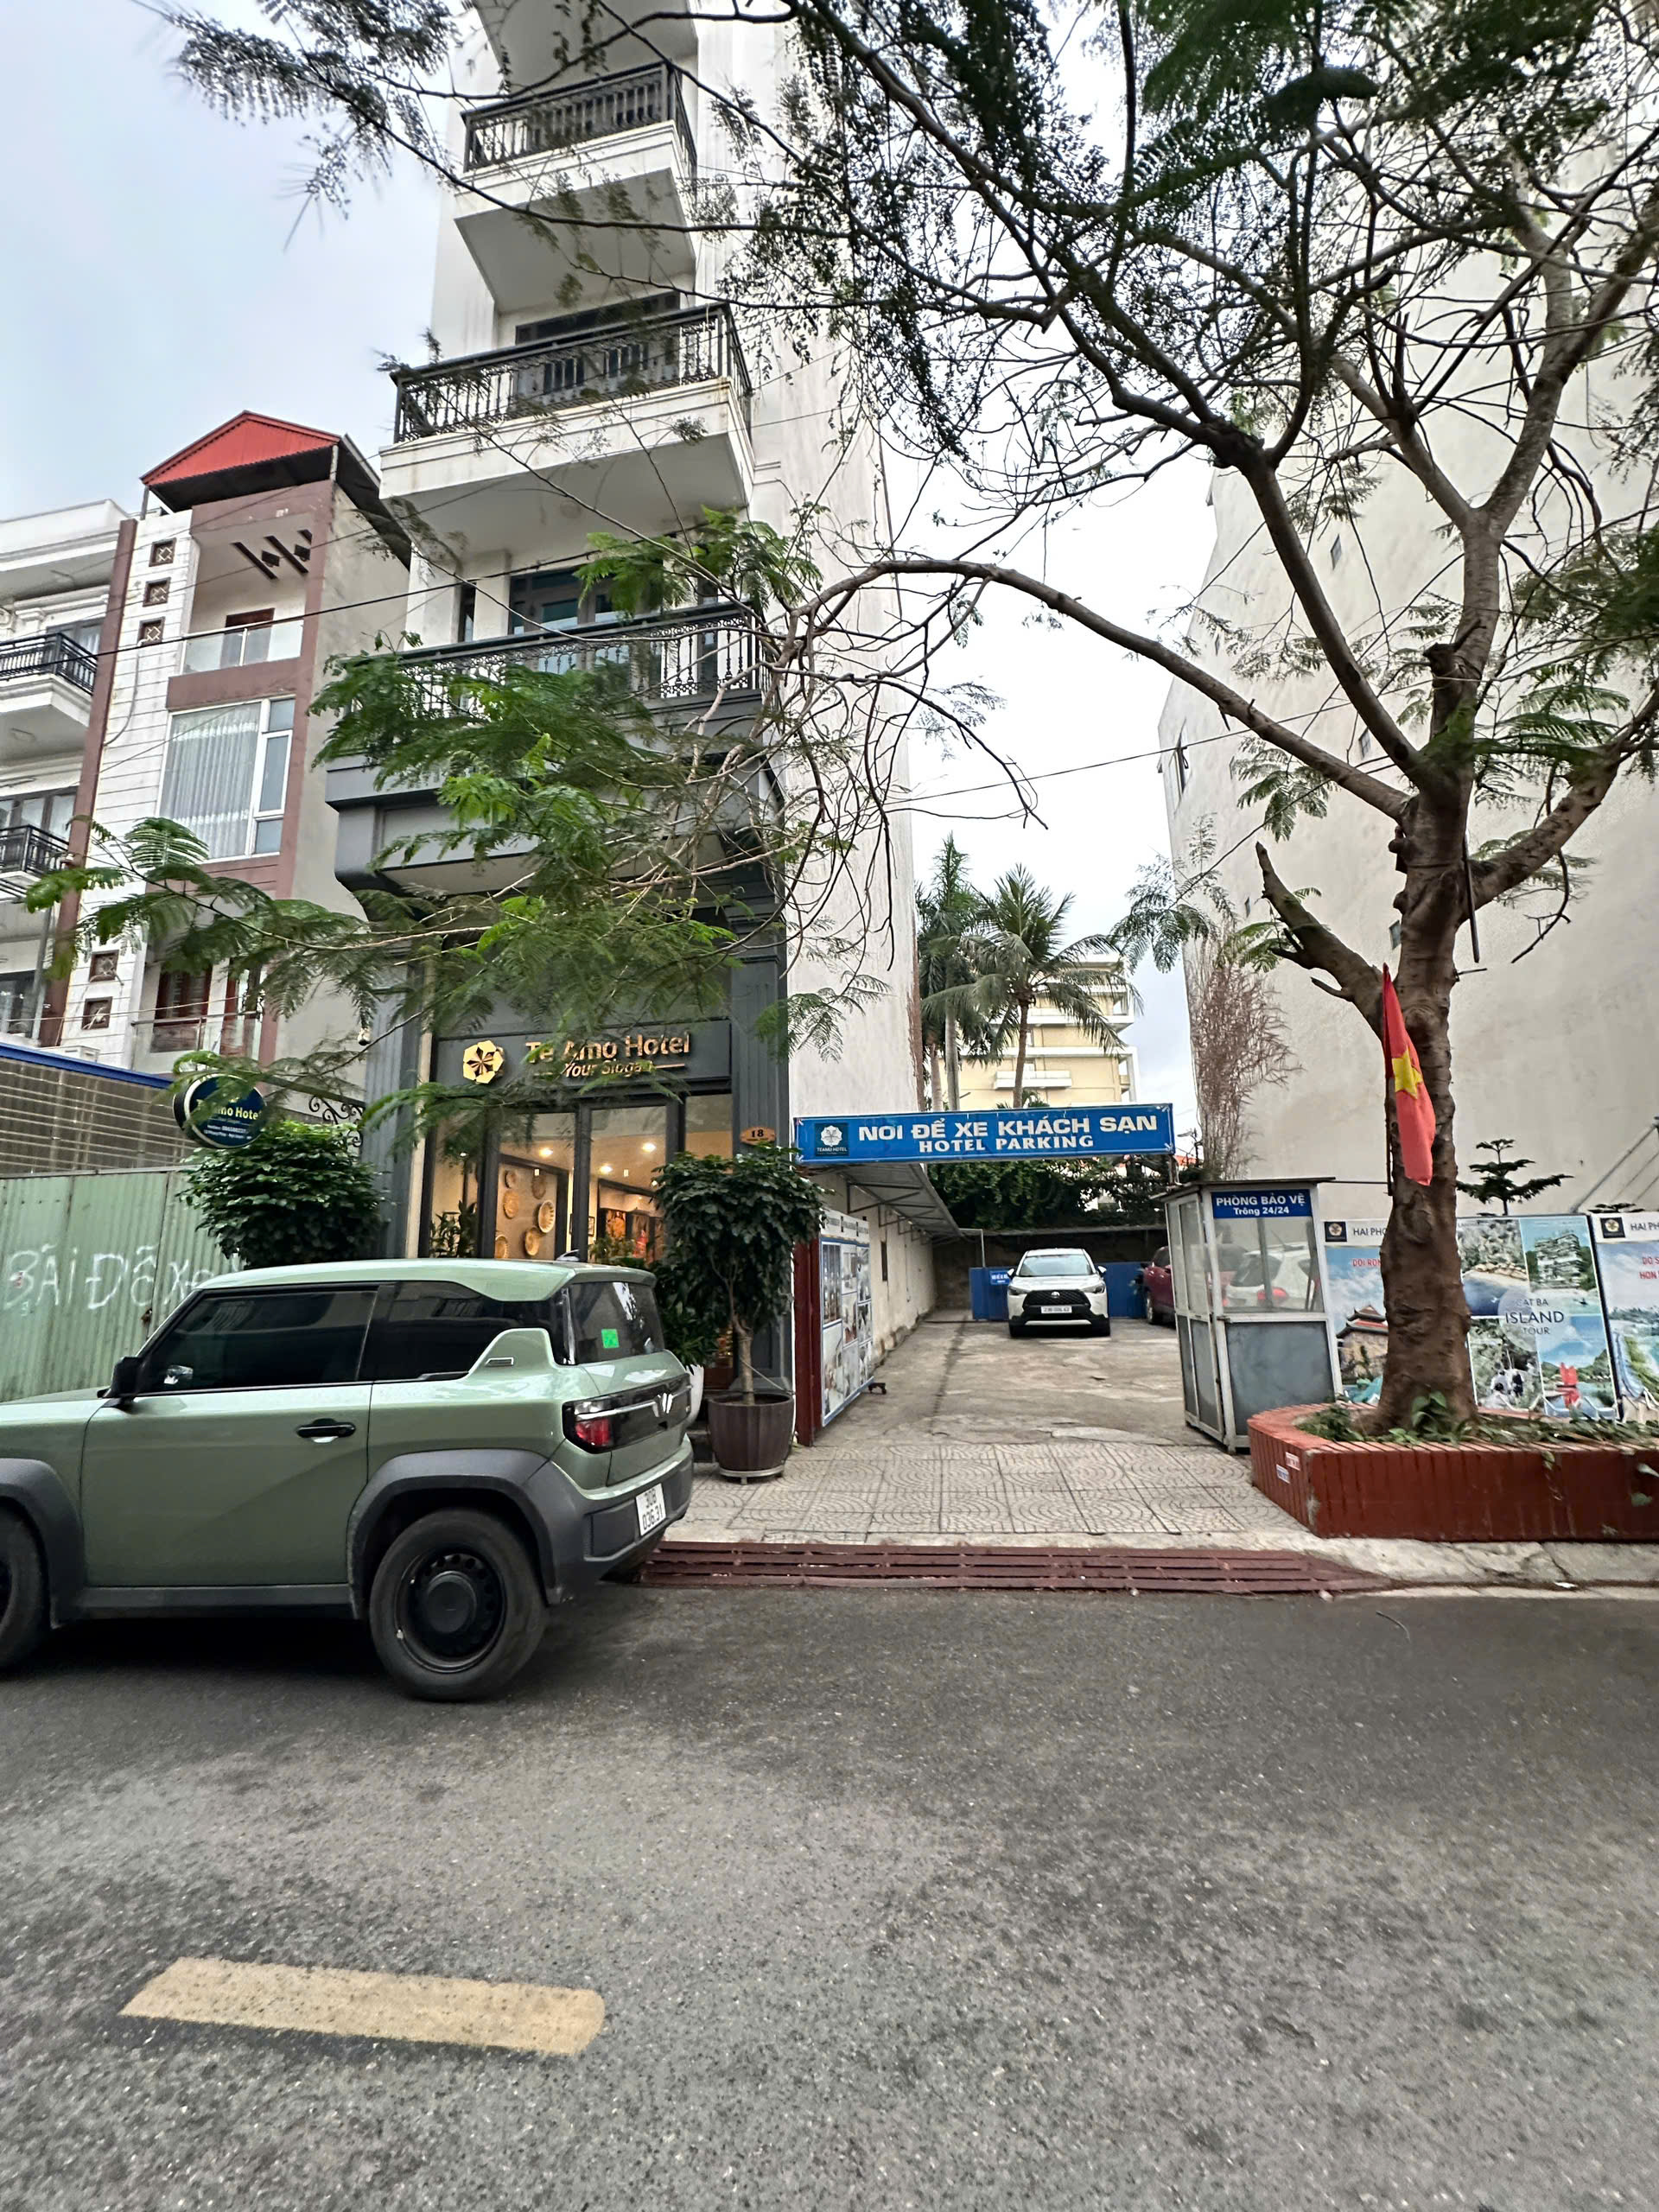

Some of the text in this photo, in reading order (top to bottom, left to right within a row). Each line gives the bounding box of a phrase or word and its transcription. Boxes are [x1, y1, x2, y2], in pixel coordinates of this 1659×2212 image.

[625, 1030, 690, 1058] Hotel
[565, 1062, 598, 1077] Your
[235, 1106, 263, 1120] Hote
[751, 1128, 765, 1138] 18
[911, 1117, 946, 1140] ĐỂ
[955, 1122, 988, 1138] XE
[997, 1115, 1090, 1136] KHÁCH
[1099, 1115, 1158, 1135] SẠN
[918, 1135, 1094, 1153] HOTEL PARKING
[1216, 1192, 1306, 1206] PHÒNG BẢO VỆ
[1262, 1206, 1290, 1215] 24/24
[1535, 1298, 1549, 1306] BA
[1505, 1310, 1565, 1324] ISLAND
[1522, 1326, 1550, 1335] TOUR
